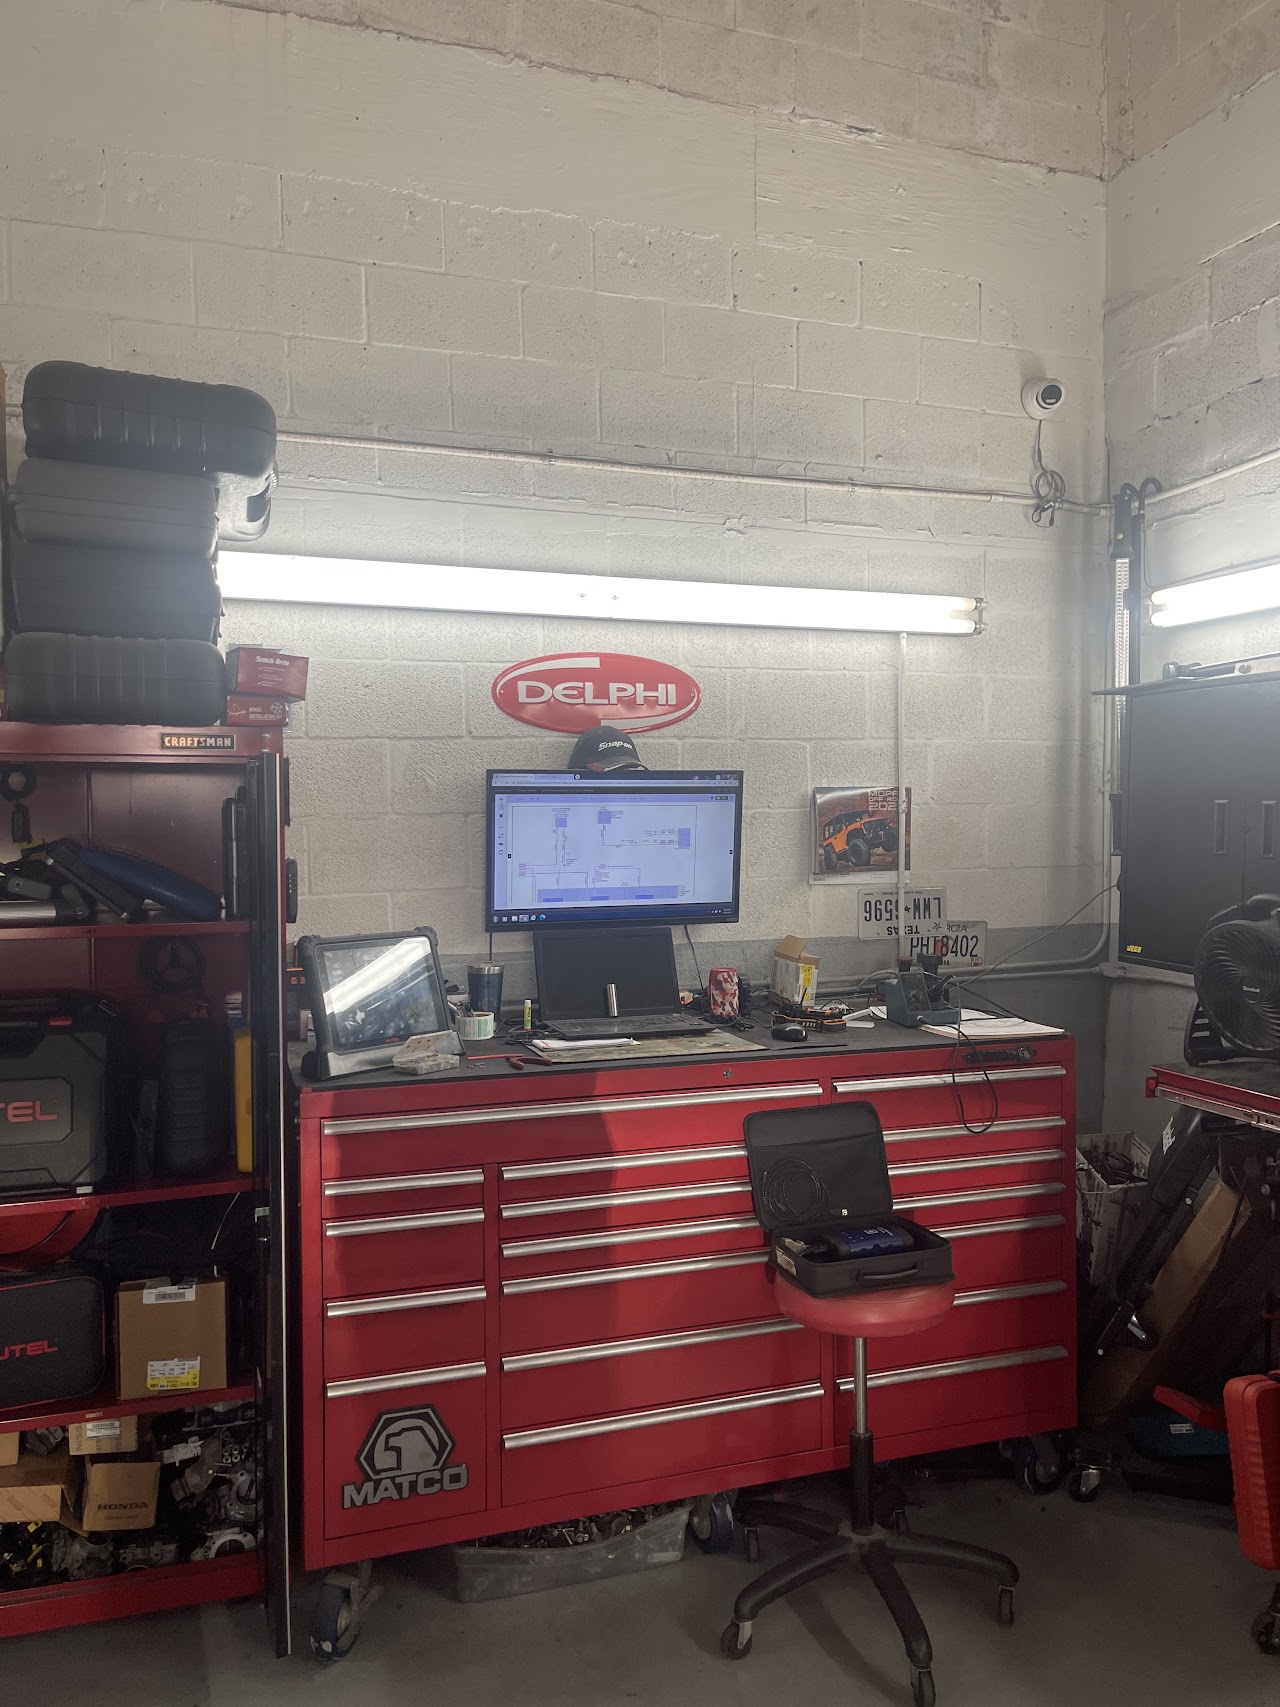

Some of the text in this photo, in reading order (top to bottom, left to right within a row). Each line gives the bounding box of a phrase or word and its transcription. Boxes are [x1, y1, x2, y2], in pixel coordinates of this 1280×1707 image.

[517, 680, 677, 706] DELPHI
[164, 736, 231, 747] CRAFTSMAN
[869, 802, 899, 810] 202
[886, 925, 920, 935] TEAS
[343, 1466, 468, 1509] MATCO
